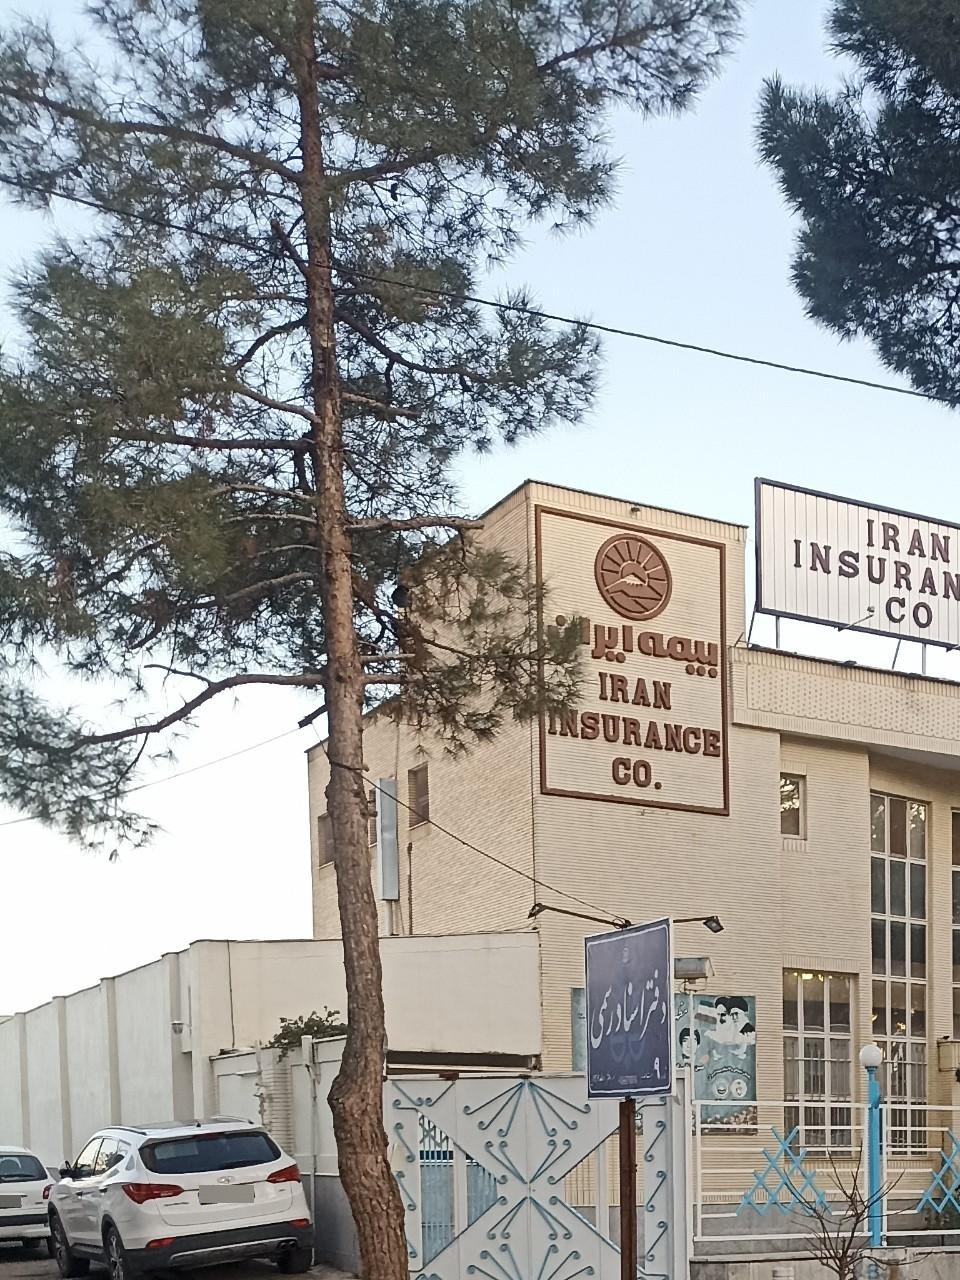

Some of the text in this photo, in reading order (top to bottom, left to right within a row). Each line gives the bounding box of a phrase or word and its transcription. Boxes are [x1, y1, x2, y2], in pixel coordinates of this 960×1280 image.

[866, 518, 951, 564] IRAN
[885, 596, 933, 629] CO
[637, 631, 718, 678] بیمه
[598, 672, 672, 710] IRAN
[549, 707, 721, 757] INSURANCE
[612, 757, 662, 790] CO.
[590, 969, 667, 1049] دفتر اسناد رسمی
